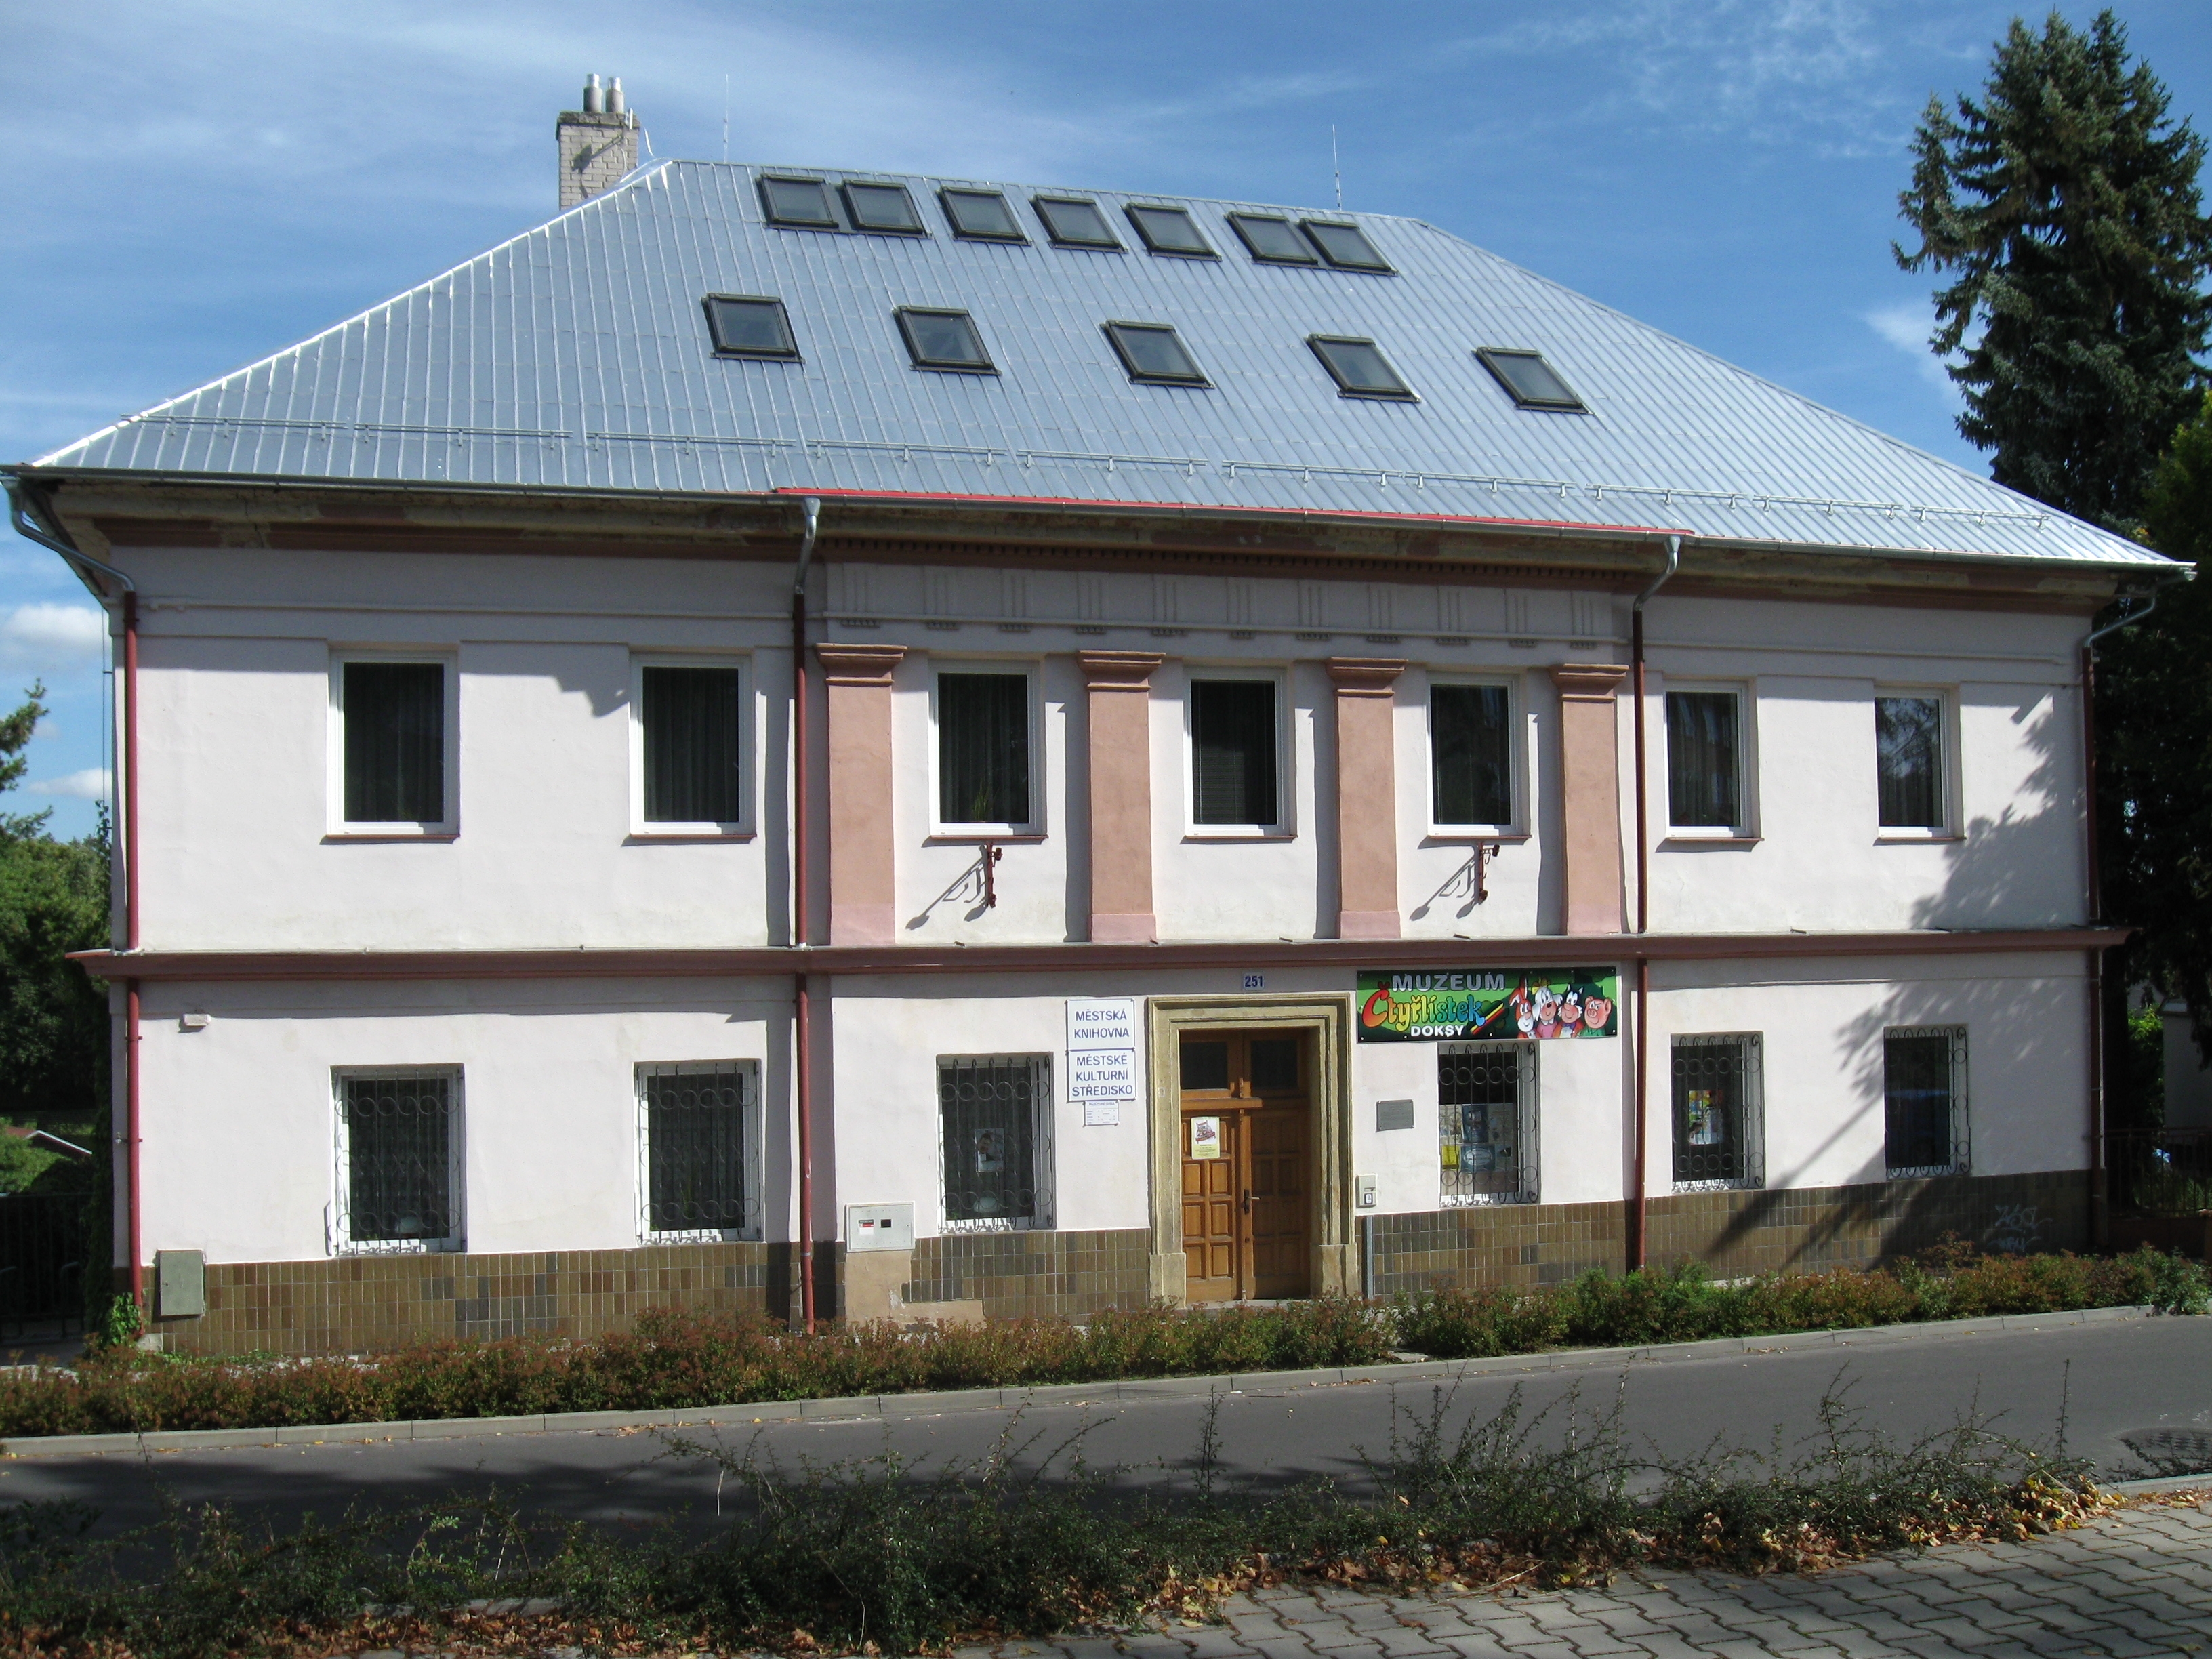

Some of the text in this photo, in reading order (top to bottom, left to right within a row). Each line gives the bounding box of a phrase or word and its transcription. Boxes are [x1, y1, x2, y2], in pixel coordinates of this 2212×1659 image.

[1245, 975, 1263, 987] 251
[1392, 973, 1505, 991] MUZEUM
[1361, 981, 1487, 1032] Čtyřlístek
[1076, 1008, 1127, 1021] MĚSTSKÁ
[1074, 1027, 1130, 1039] KNIHOVNA
[1410, 1024, 1465, 1038] DOKSY
[1076, 1053, 1128, 1066] MĚSTSKÉ
[1076, 1068, 1128, 1082] KULTURNÍ
[1072, 1084, 1133, 1097] STŘEDISKO
